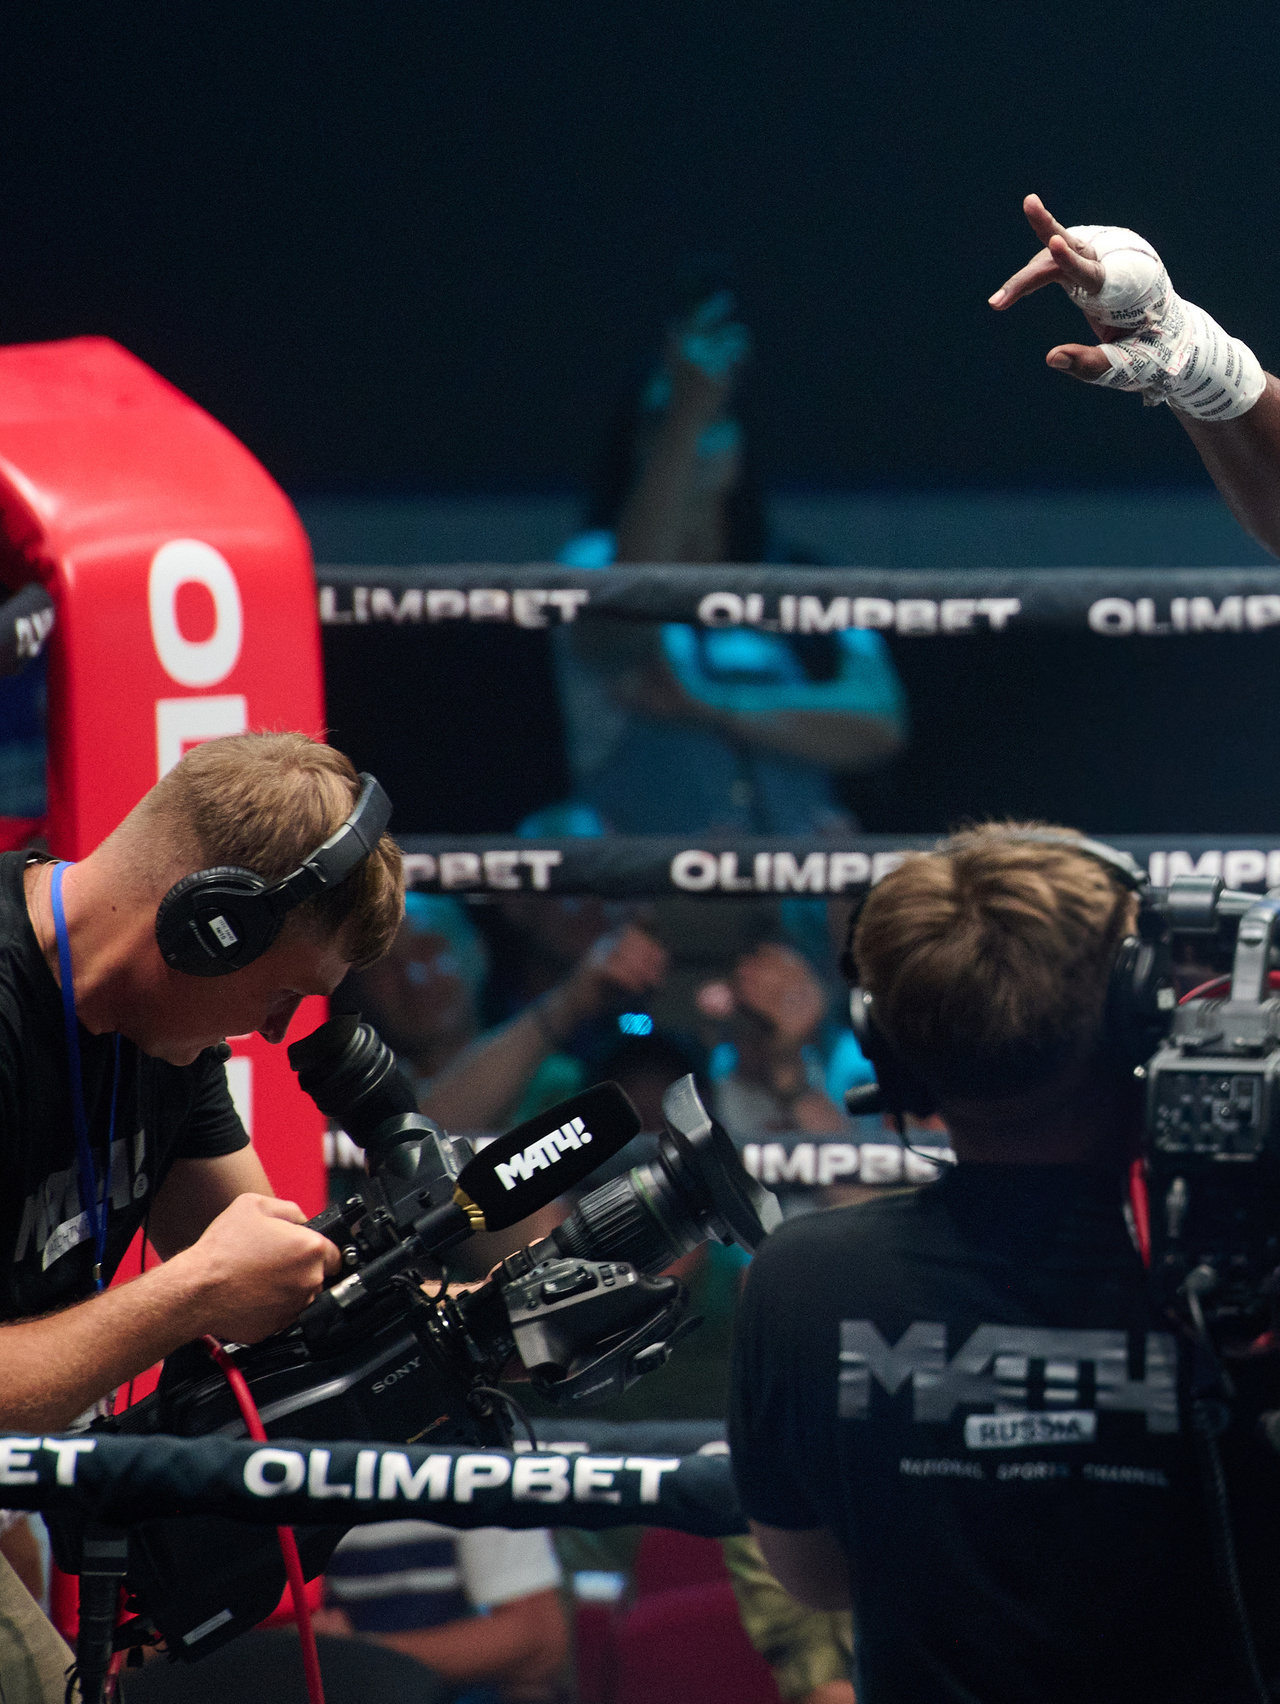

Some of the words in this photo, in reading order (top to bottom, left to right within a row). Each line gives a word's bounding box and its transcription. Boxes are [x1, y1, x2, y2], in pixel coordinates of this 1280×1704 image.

[699, 592, 1021, 635] OLIMPBET
[371, 1356, 422, 1395] SONY
[243, 1447, 681, 1503] OLIMPBET
